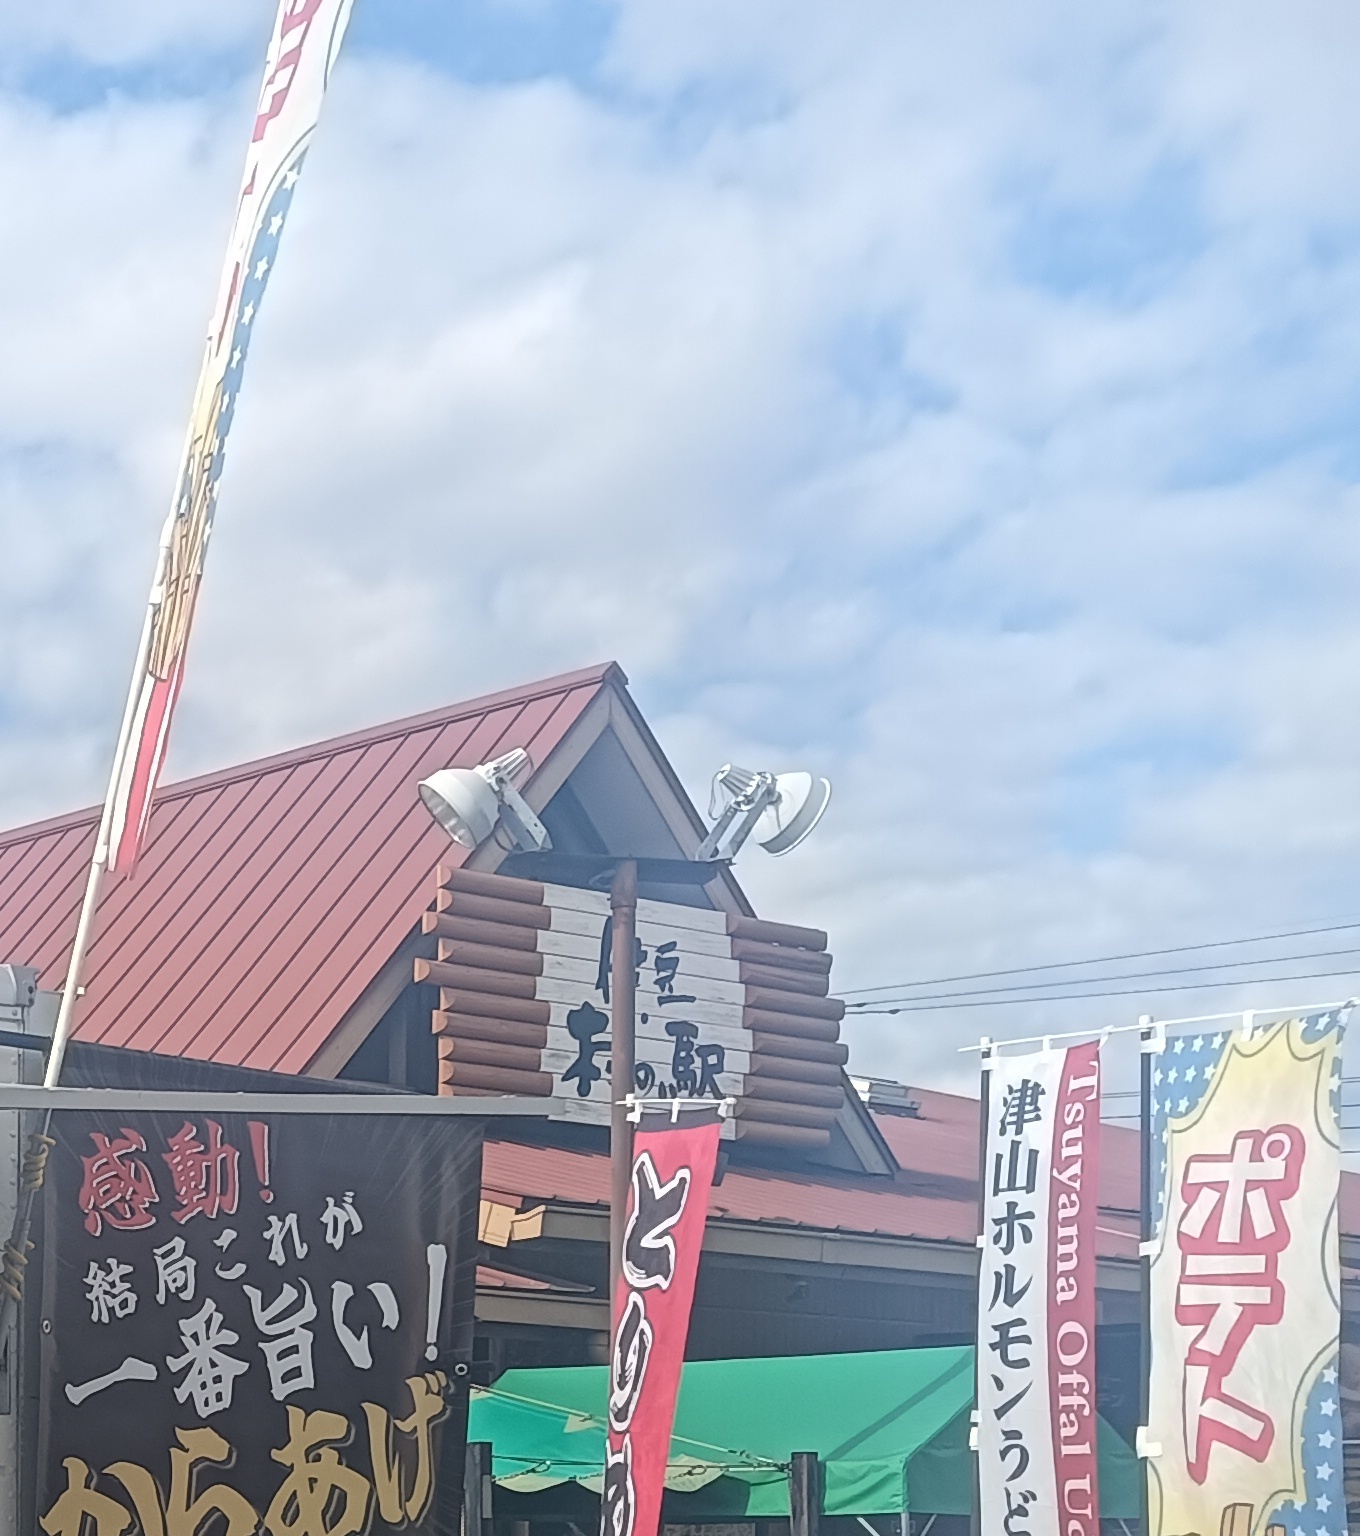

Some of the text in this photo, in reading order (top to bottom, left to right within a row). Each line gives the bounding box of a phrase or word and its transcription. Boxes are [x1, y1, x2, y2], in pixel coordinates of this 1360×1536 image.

[79, 1120, 274, 1238] 感動!
[1049, 1059, 1098, 1306] Tsuyama
[65, 1241, 448, 1418] 一番旨い!
[84, 1191, 366, 1326] 結局これが
[1176, 1128, 1305, 1484] ポテト
[1055, 1321, 1091, 1461] Offal
